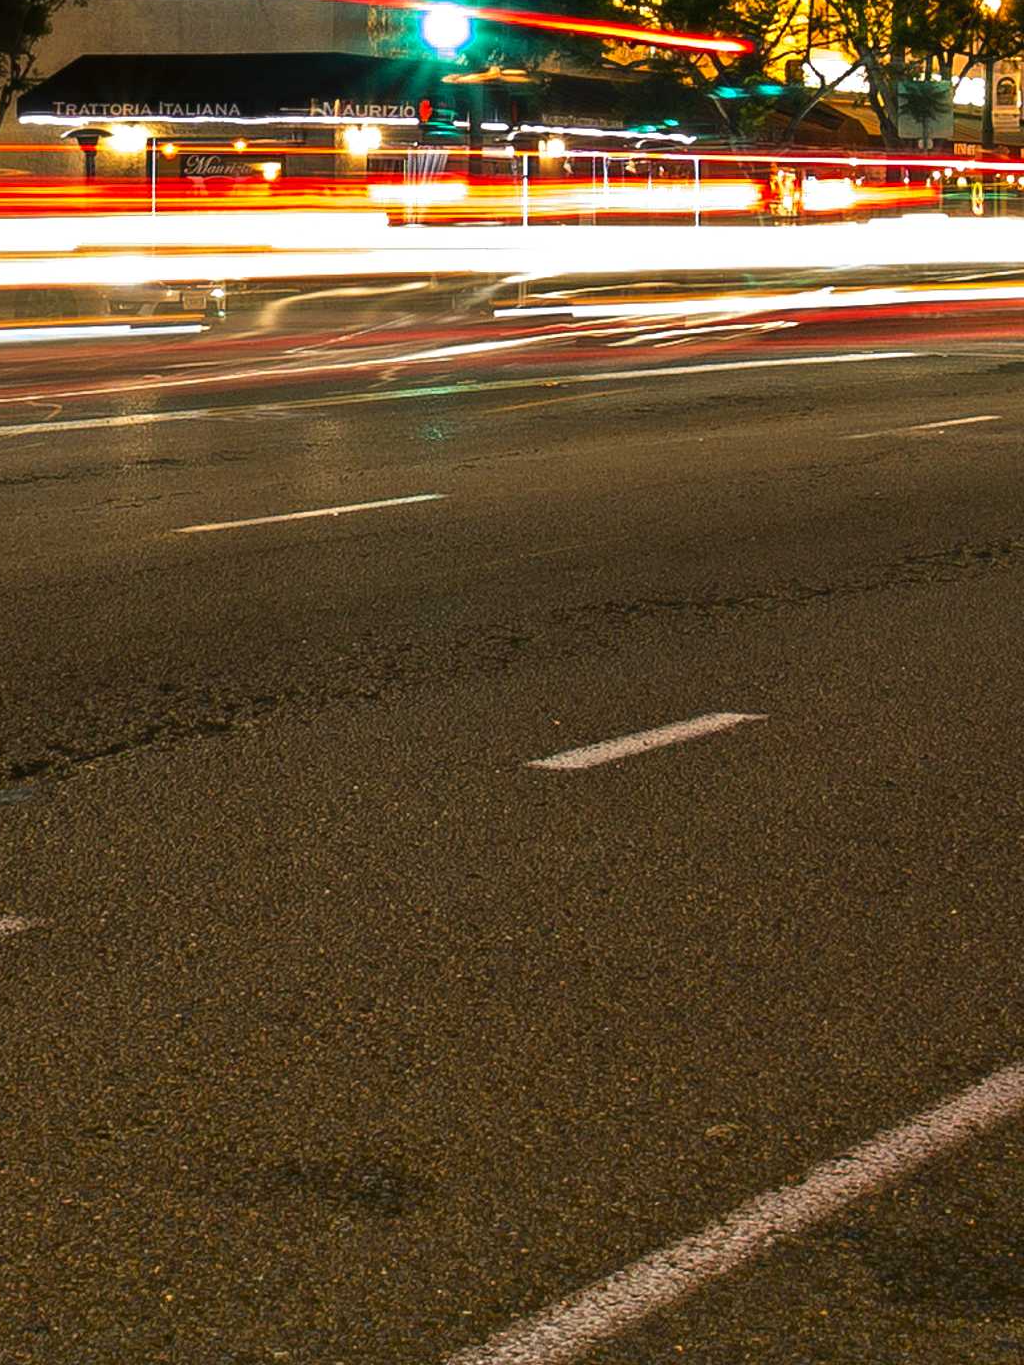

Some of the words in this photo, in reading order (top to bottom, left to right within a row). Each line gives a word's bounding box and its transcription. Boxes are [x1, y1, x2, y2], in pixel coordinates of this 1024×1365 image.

[52, 100, 152, 117] TRATTORIA
[159, 100, 241, 116] ITALIANA
[323, 101, 416, 118] MAURIZIO
